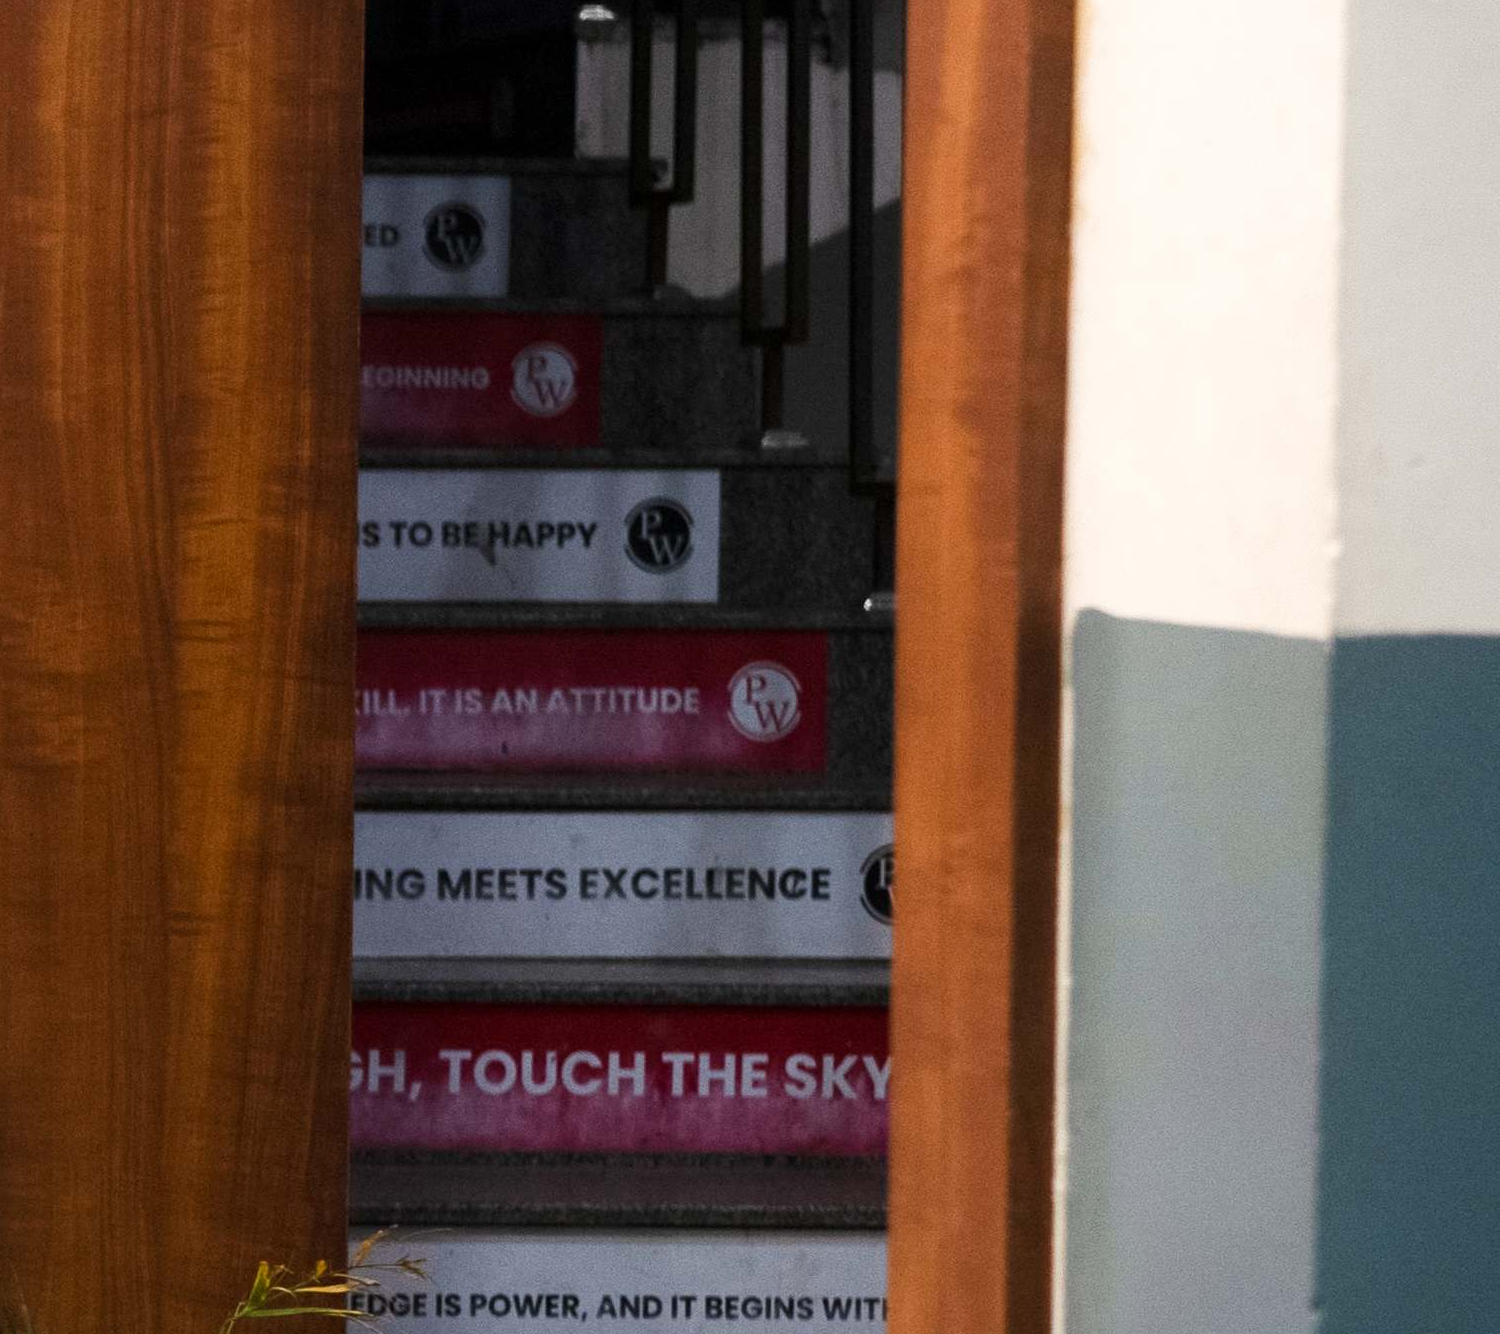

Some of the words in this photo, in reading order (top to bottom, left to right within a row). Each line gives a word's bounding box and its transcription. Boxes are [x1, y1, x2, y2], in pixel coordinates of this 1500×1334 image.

[388, 521, 434, 550] TO
[441, 520, 484, 550] BE
[488, 520, 599, 550] HAPPY
[418, 687, 443, 716] IT
[451, 687, 483, 716] IS
[494, 687, 540, 716] AN
[545, 687, 699, 716] ATTITUDE
[436, 867, 568, 902] MEETS
[579, 866, 831, 901] EXCELLENCE
[440, 1049, 648, 1097] TOUCH
[660, 1051, 770, 1099] THE
[435, 1292, 462, 1318] IS
[596, 1294, 663, 1320] AND
[670, 1294, 698, 1320] IT
[704, 1295, 814, 1321] BEGINS
